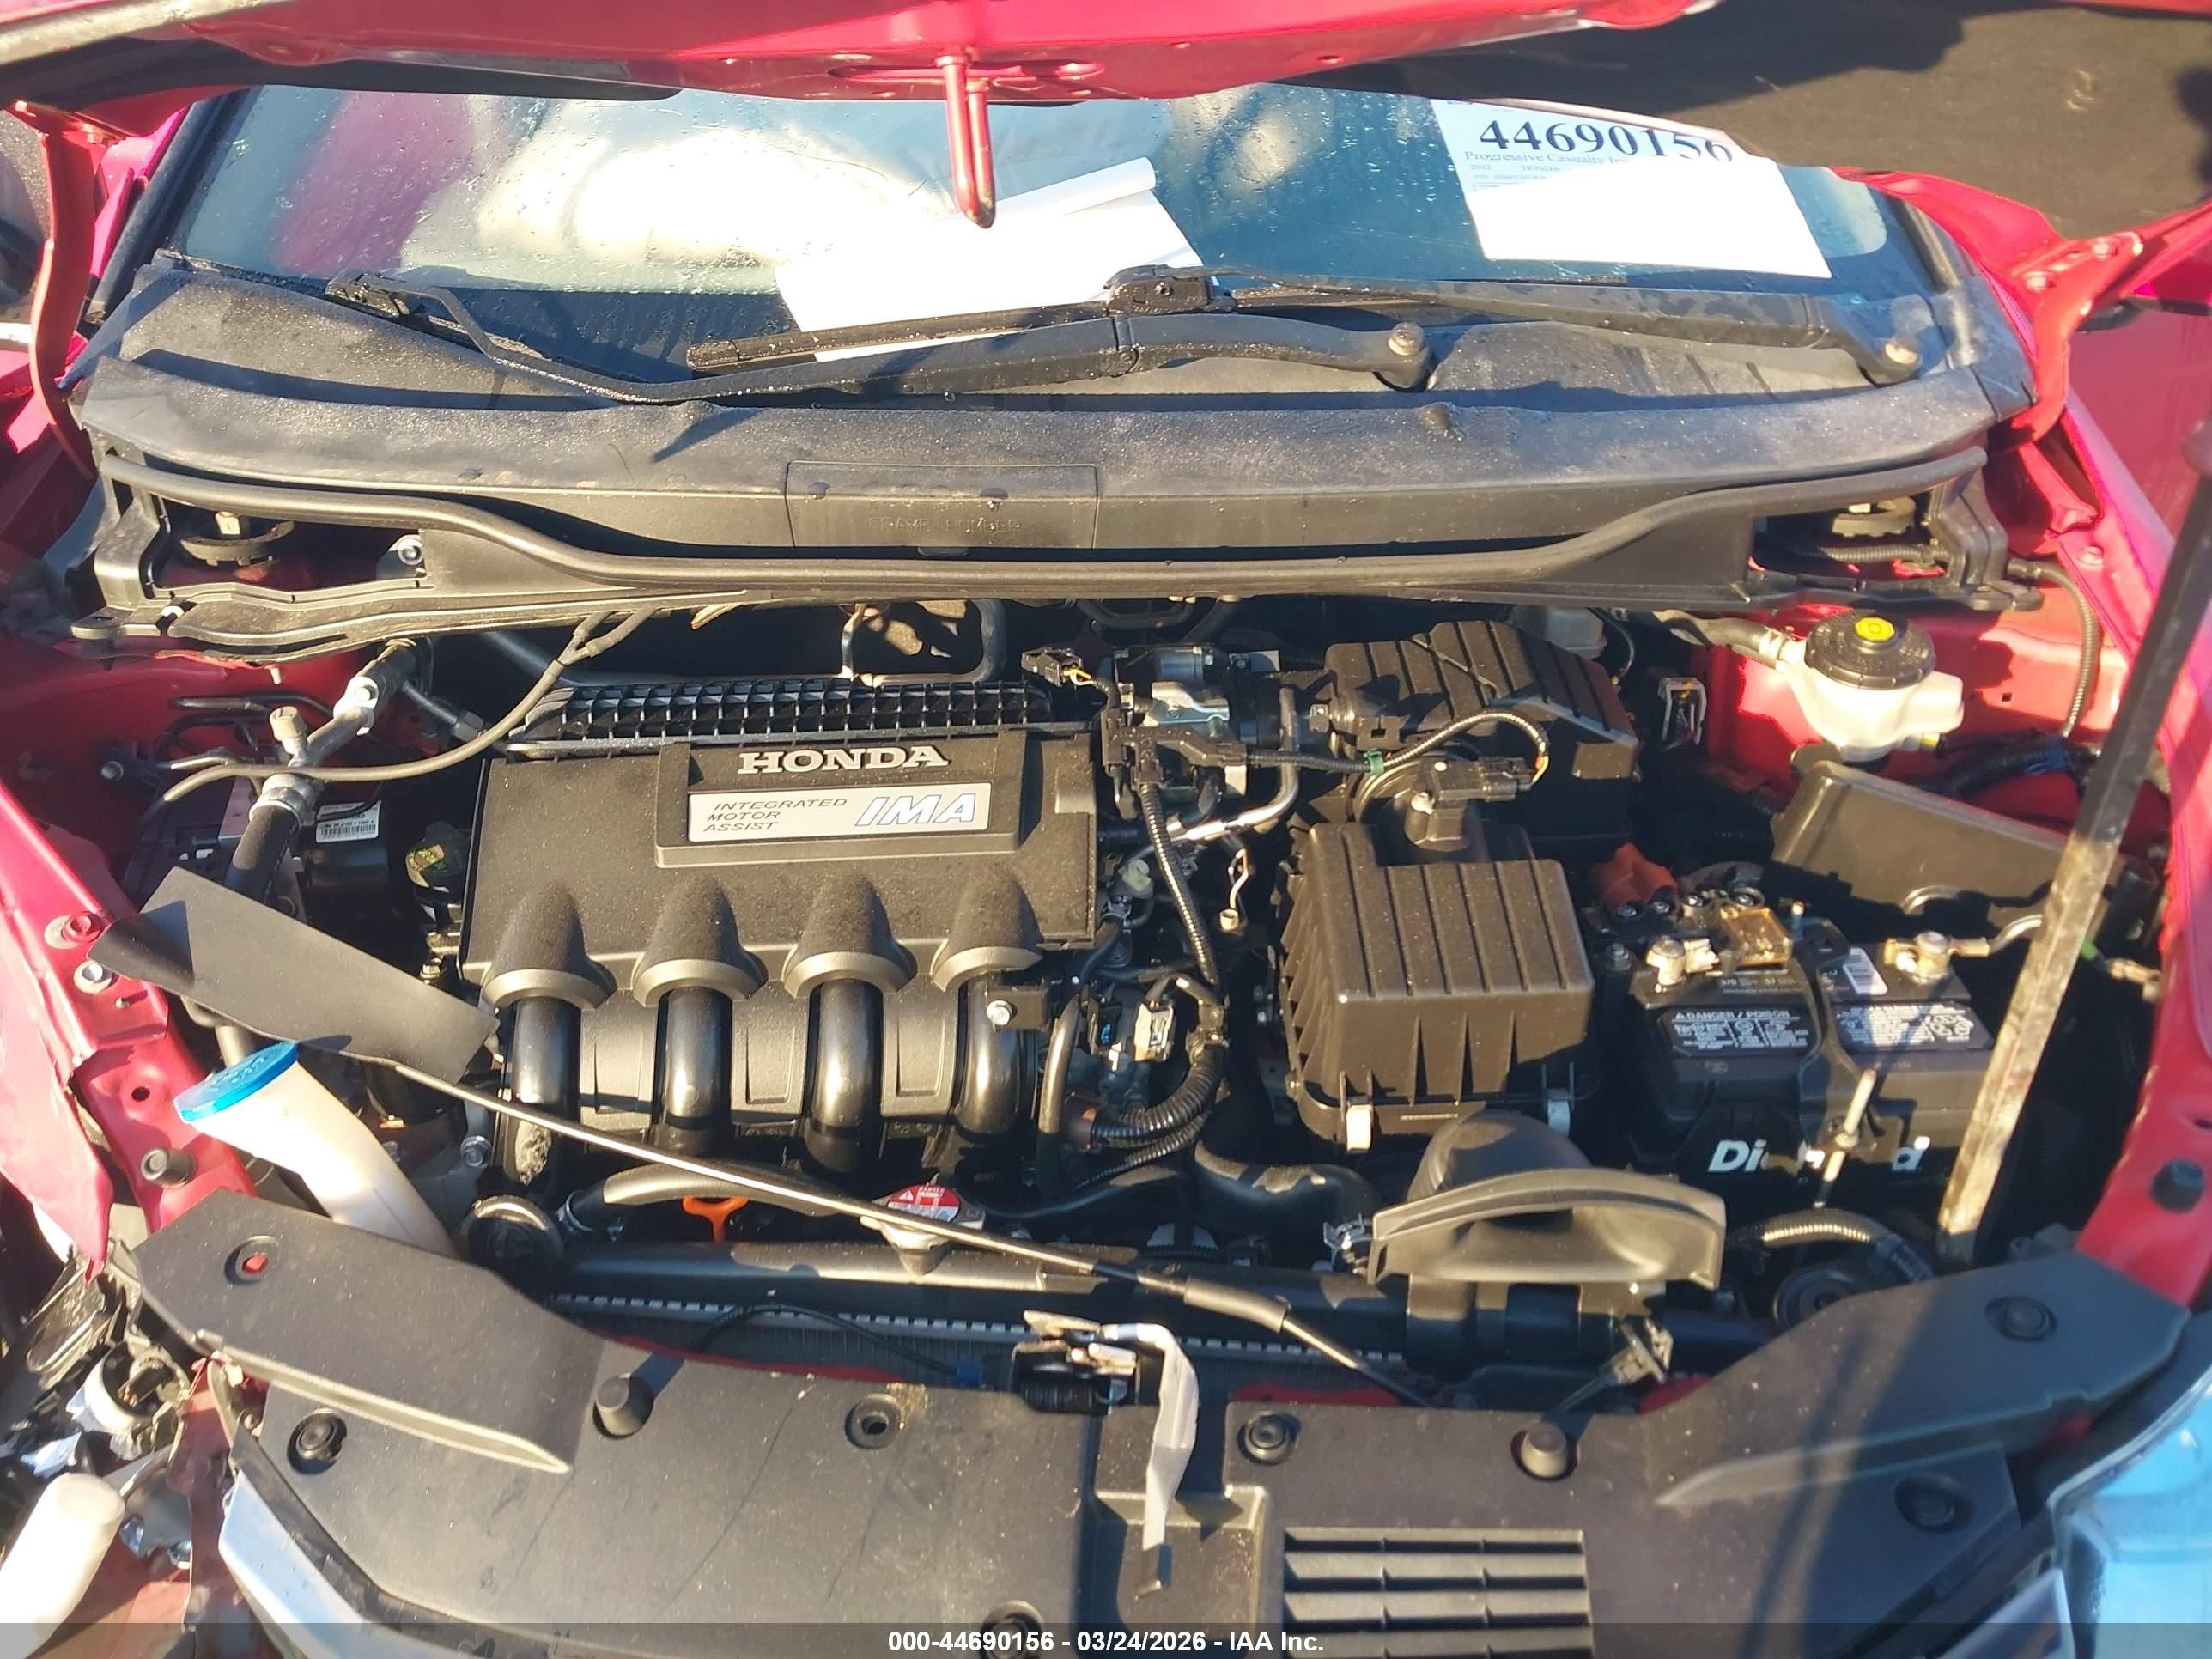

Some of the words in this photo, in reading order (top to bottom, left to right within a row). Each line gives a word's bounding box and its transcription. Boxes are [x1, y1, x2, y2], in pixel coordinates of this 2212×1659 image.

[1480, 120, 1733, 163] 44690156
[1465, 151, 1544, 162] Progressive
[1547, 154, 1605, 165] Casualty
[737, 745, 949, 775] HONDA
[714, 798, 848, 811] INTEGRATED
[854, 792, 976, 827] IMA
[708, 811, 781, 822] MOTOR
[703, 822, 779, 833] ASSIST
[1686, 1011, 1735, 1020] DANGER
[1746, 1010, 1791, 1018] POISON
